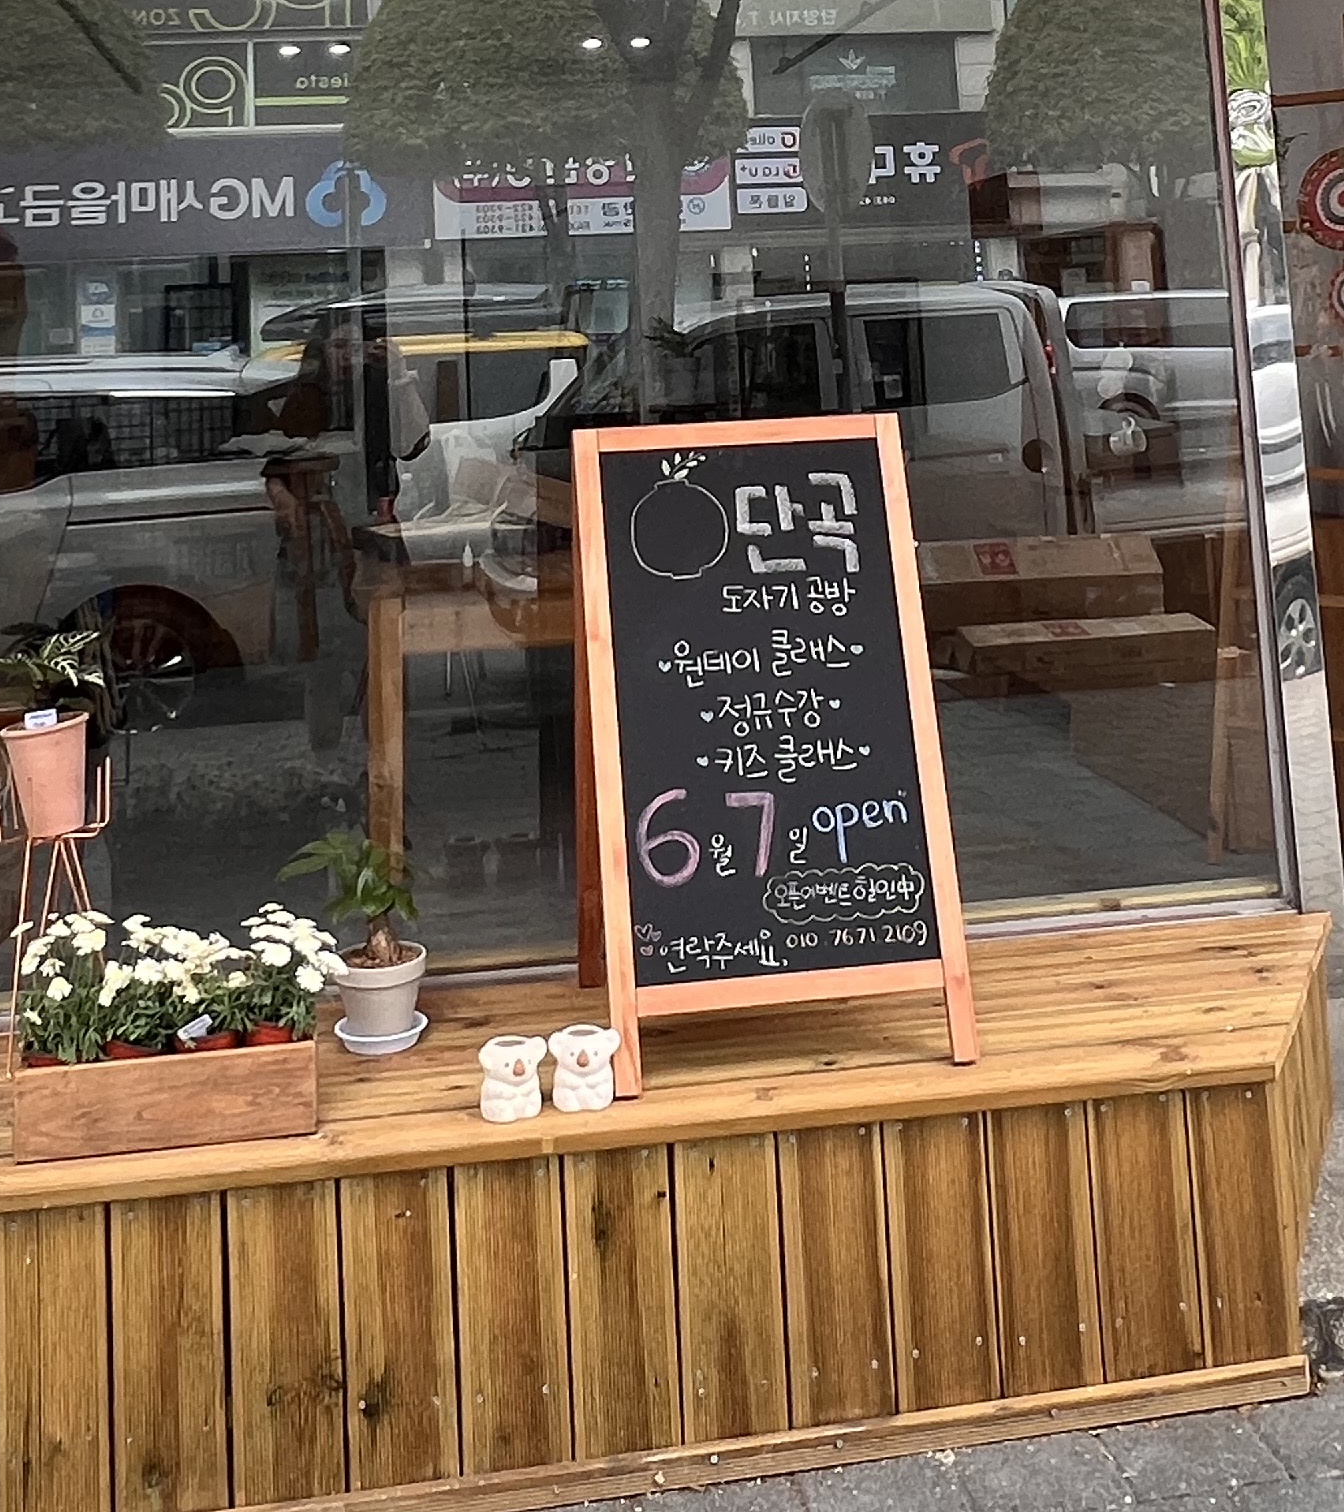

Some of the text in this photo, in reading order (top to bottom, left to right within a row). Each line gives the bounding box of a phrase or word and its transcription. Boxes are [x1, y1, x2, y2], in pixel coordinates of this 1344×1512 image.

[734, 471, 860, 574] 단곡
[721, 576, 856, 617] 도자기 공방
[673, 629, 851, 688] 원데이 클래스
[716, 688, 824, 738] 정규수강
[714, 735, 859, 783] 키즈 클래스
